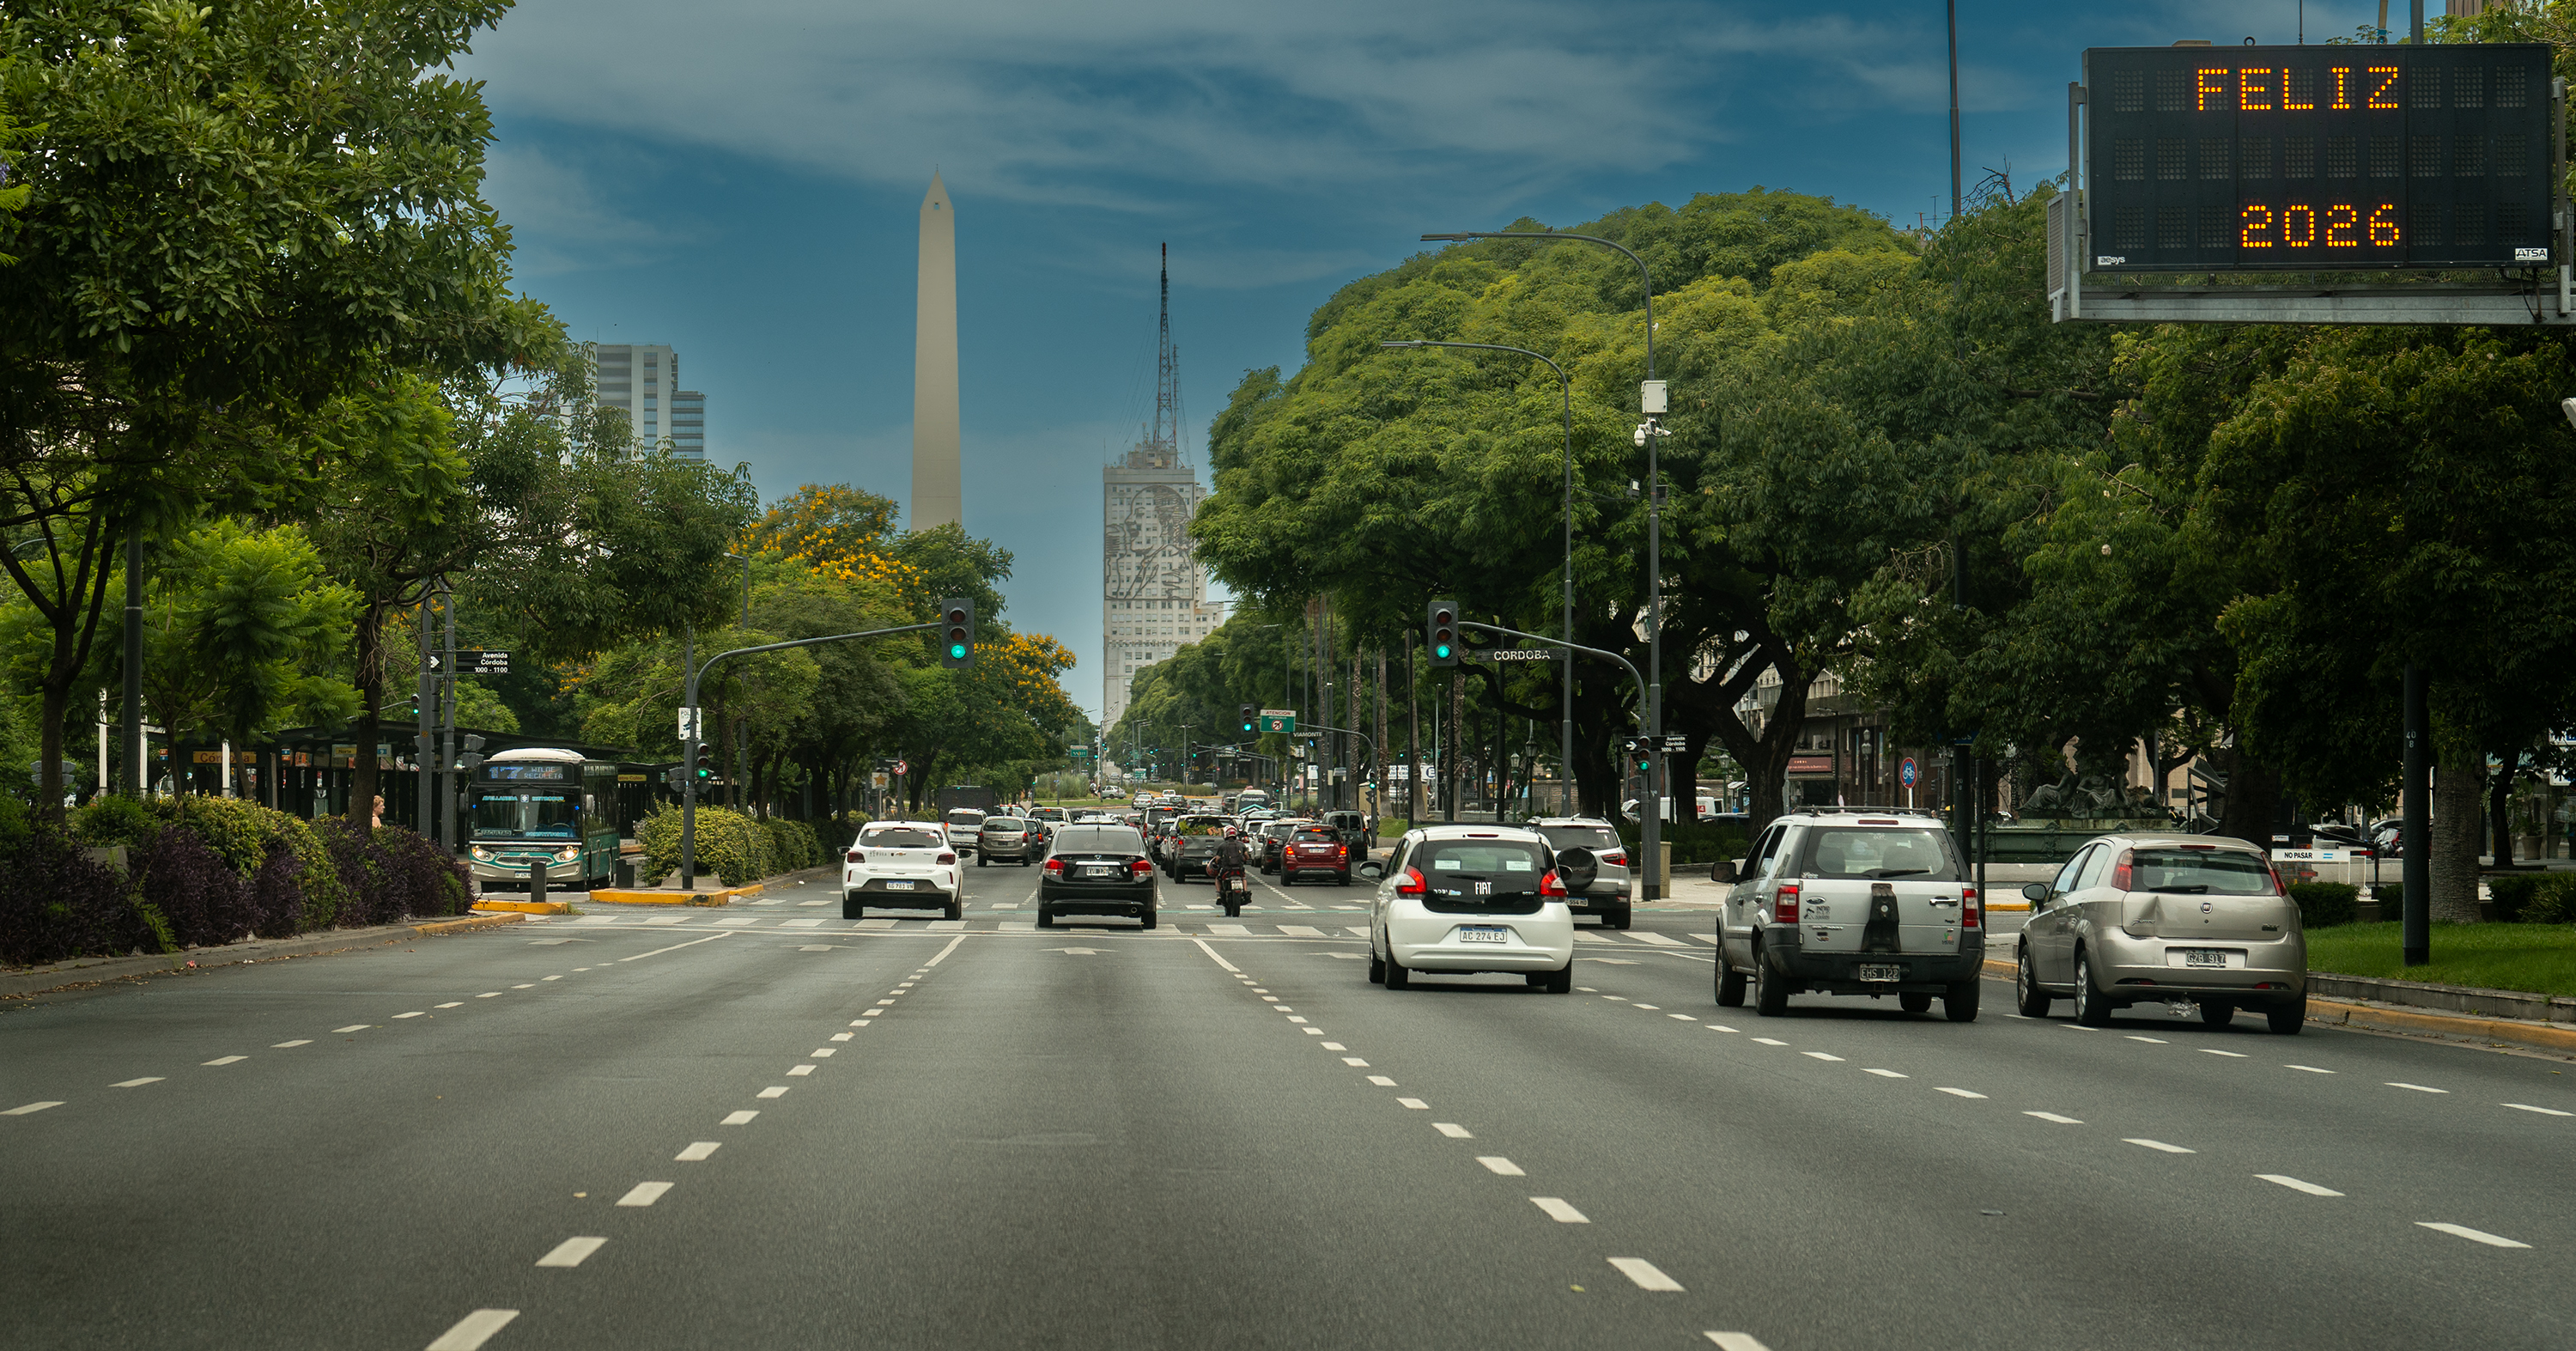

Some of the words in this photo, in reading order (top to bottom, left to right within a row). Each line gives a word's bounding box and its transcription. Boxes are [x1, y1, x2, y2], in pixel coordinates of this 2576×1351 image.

[2197, 66, 2399, 111] FELIZ
[2241, 204, 2400, 248] 2026
[2516, 249, 2547, 258] ATSA
[2099, 256, 2125, 265] aesys
[1494, 650, 1551, 660] CORDOBA
[200, 752, 249, 763] Córoa
[489, 766, 523, 779] 17
[1474, 882, 1492, 895] FIAT
[1494, 933, 1505, 941] EJ
[1861, 968, 1877, 978] EHS
[1882, 968, 1899, 979] 122
